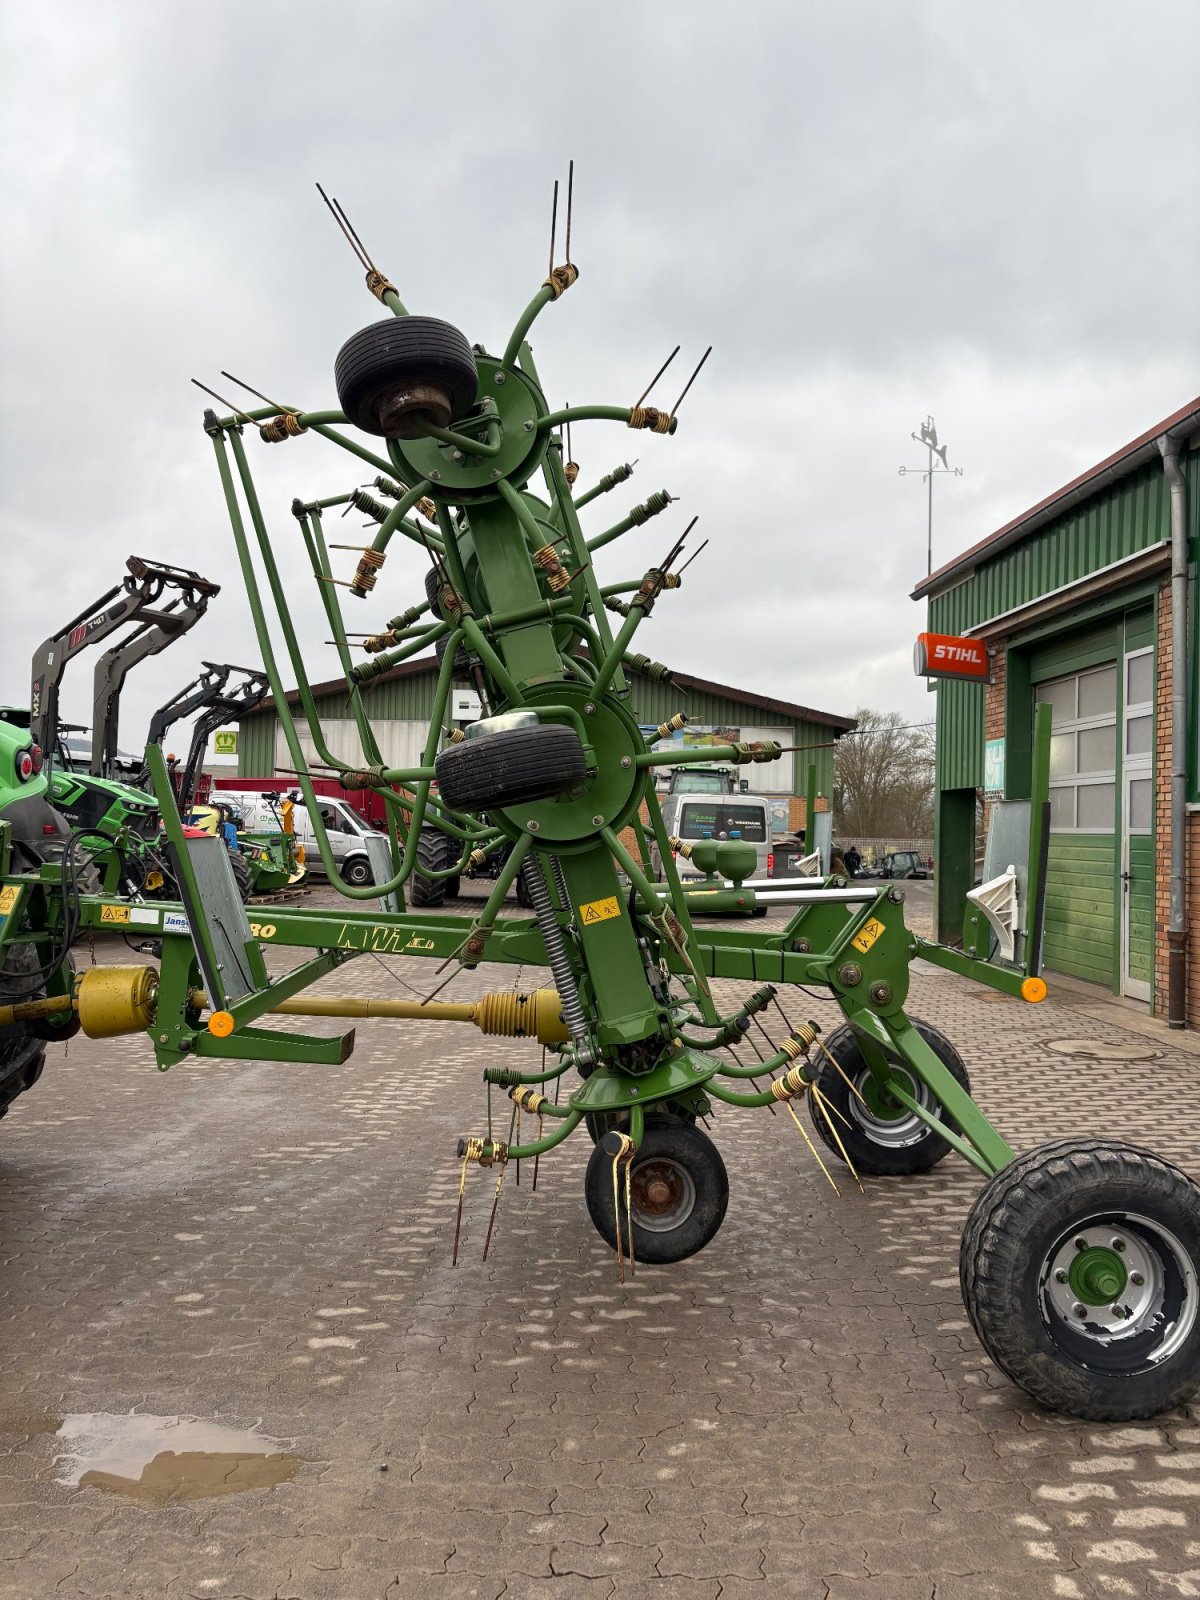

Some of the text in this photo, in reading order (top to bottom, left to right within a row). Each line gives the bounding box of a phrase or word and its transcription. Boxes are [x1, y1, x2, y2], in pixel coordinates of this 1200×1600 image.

[934, 645, 981, 663] STIHL
[32, 692, 40, 717] MX
[165, 916, 189, 926] Jans
